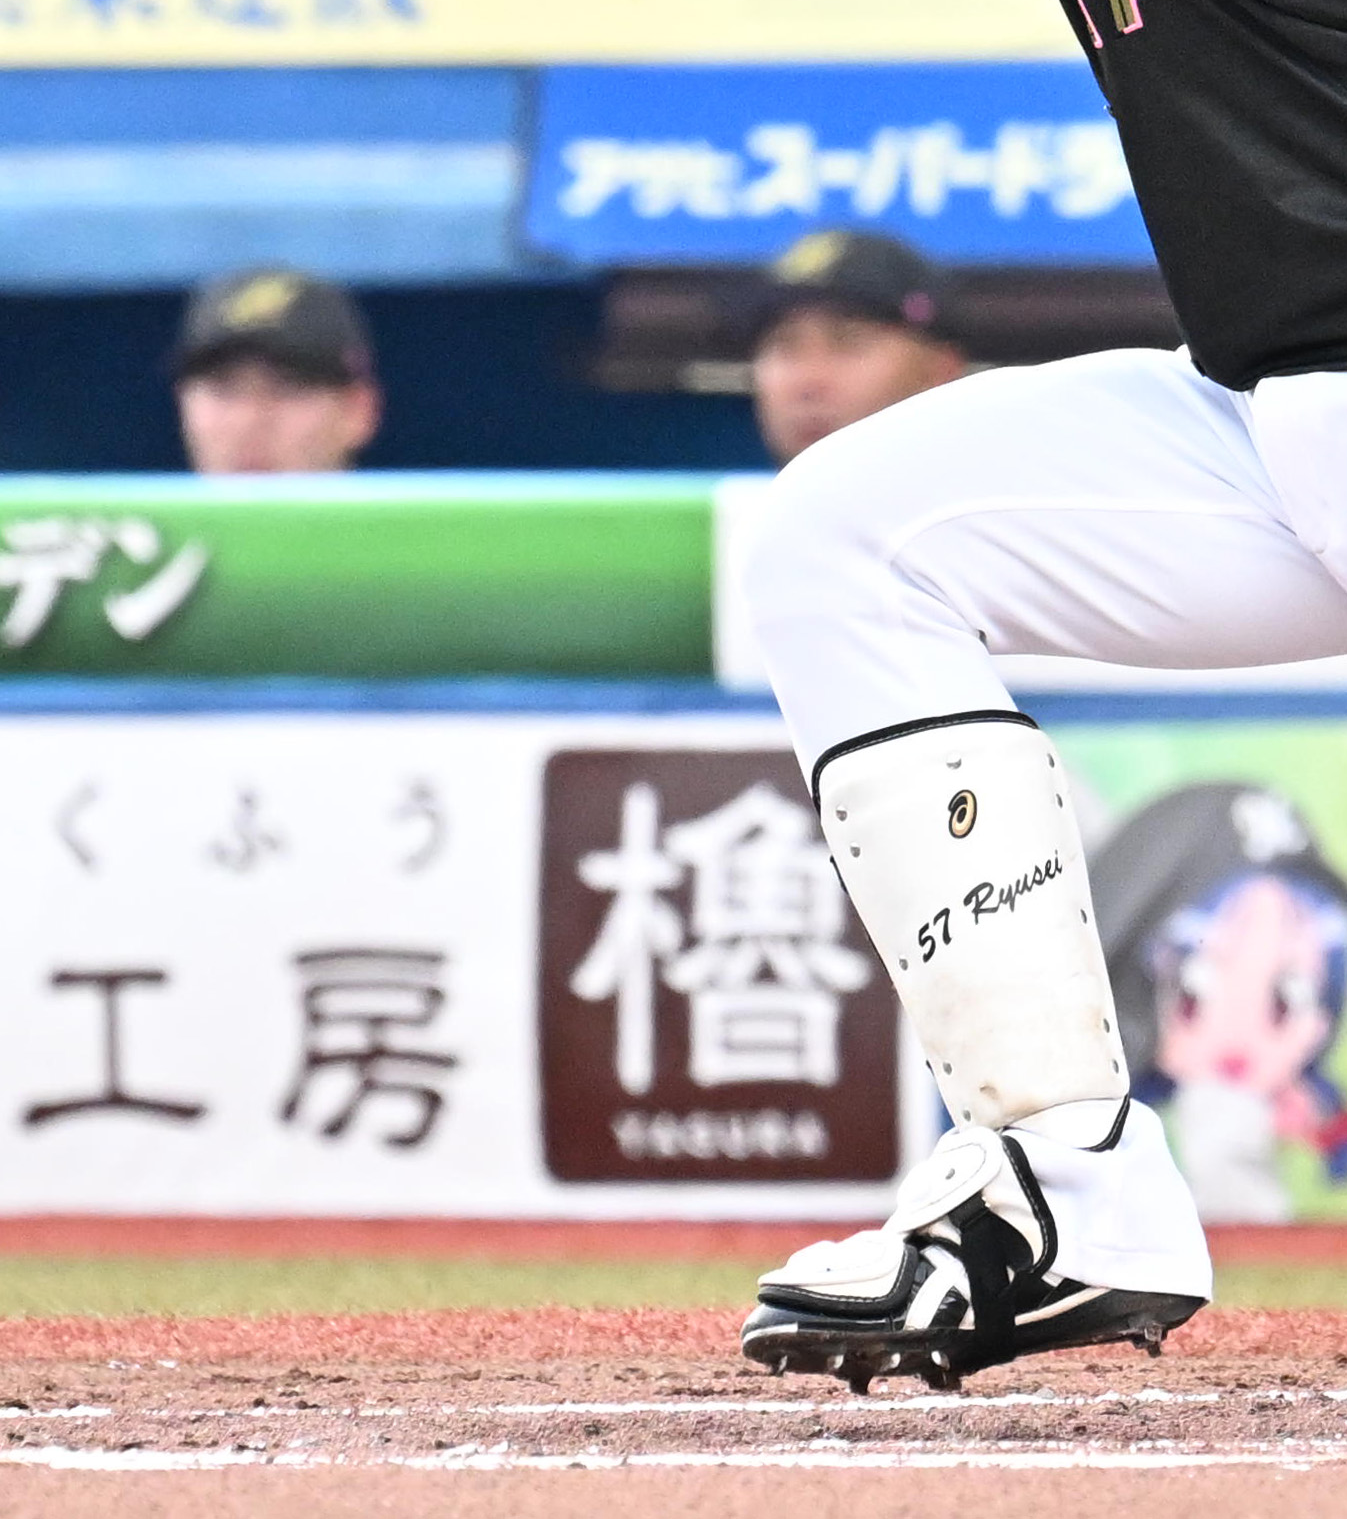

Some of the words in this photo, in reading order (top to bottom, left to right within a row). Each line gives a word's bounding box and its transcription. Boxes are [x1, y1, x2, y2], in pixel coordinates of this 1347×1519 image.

[917, 907, 952, 964] 57
[963, 849, 1063, 925] Ryusei
[20, 947, 461, 1153] 工房
